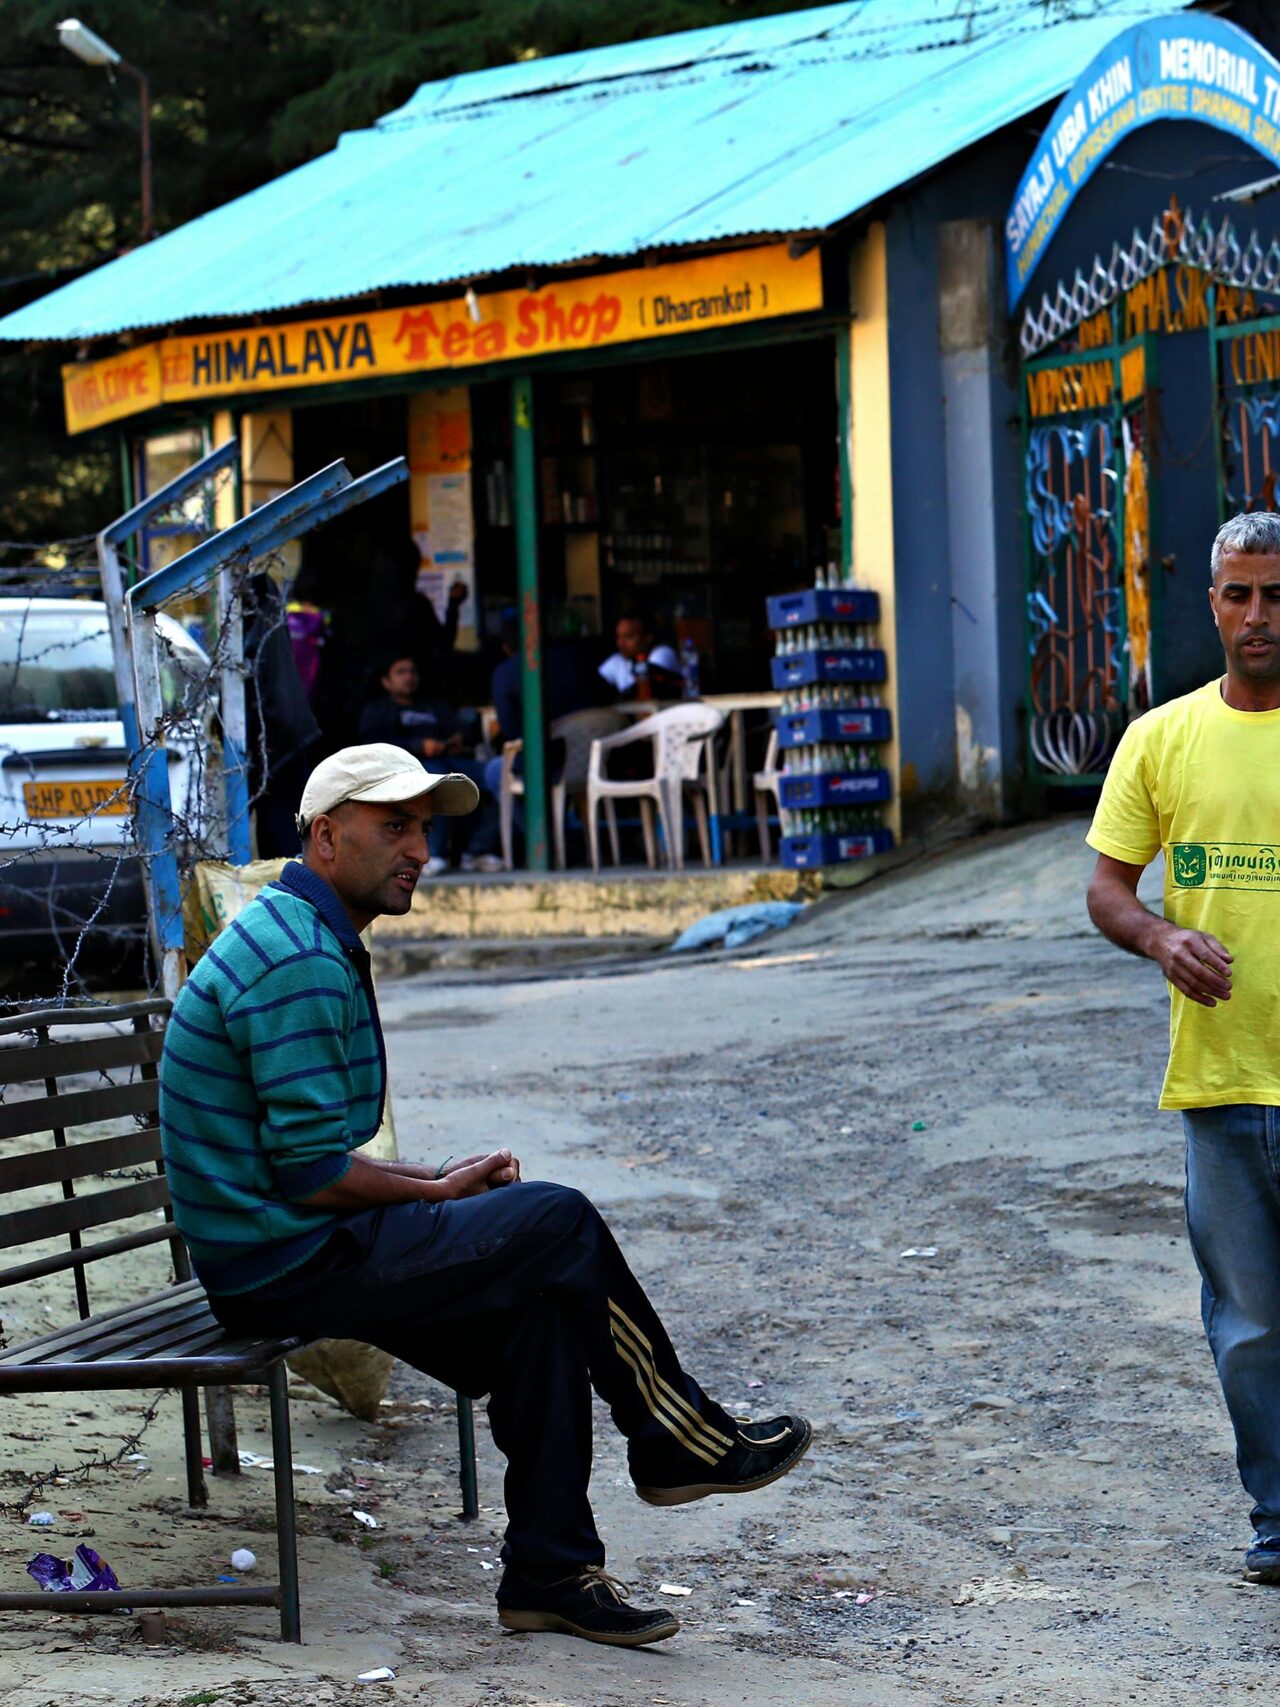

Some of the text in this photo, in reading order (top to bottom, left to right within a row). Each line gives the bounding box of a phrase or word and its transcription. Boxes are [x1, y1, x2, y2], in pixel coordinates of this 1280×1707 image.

[1088, 56, 1133, 124] KHIN
[1160, 38, 1259, 106] MEMORIAL
[192, 321, 377, 387] HIMALAYA
[393, 308, 508, 363] Tea
[514, 291, 622, 347] Shop
